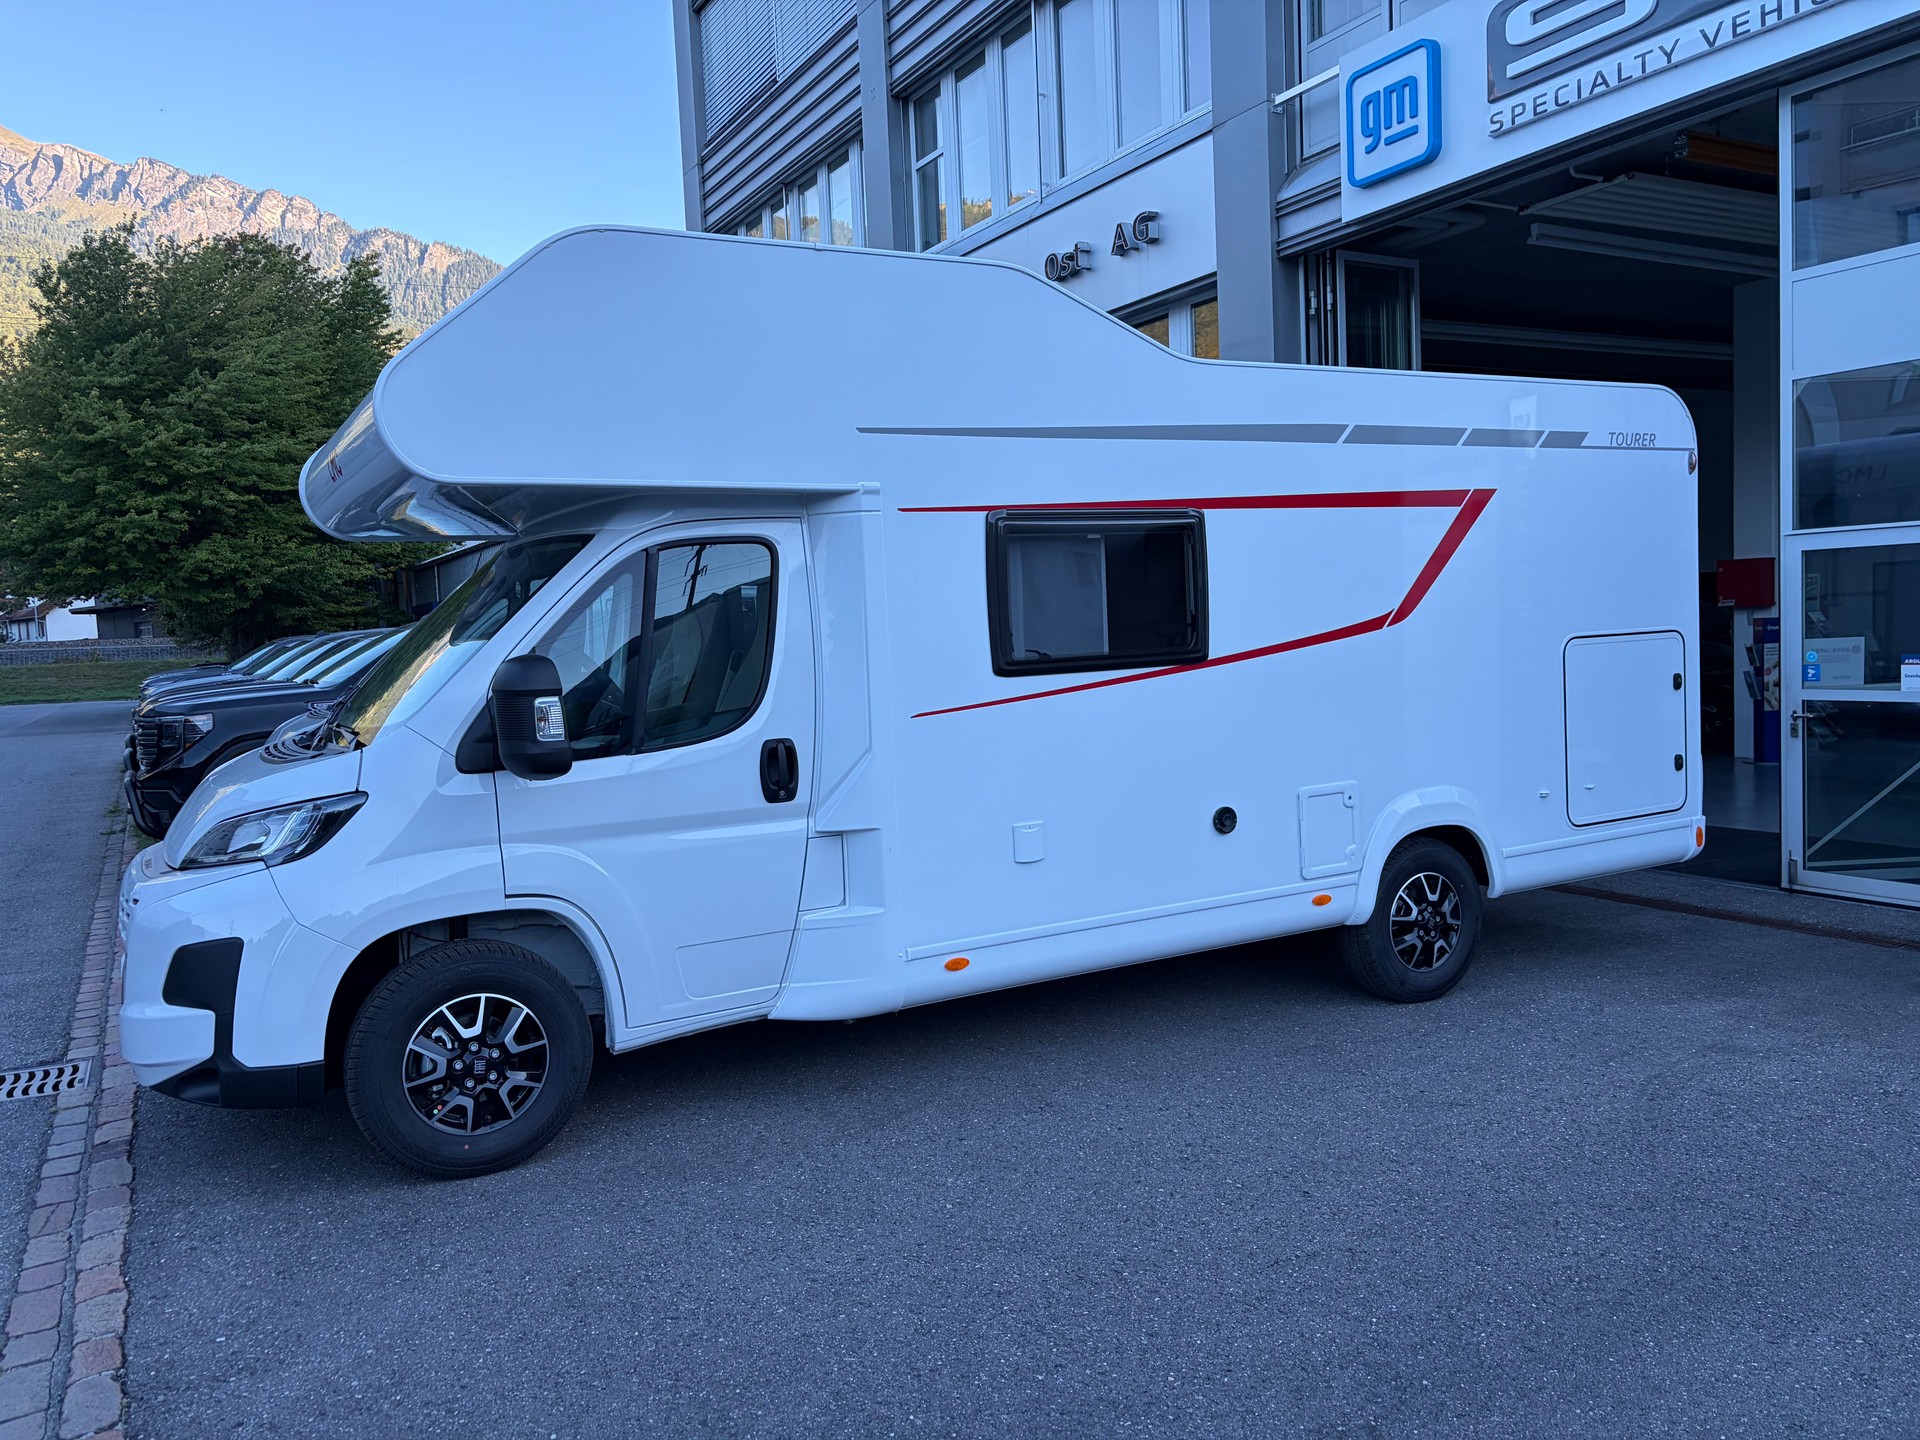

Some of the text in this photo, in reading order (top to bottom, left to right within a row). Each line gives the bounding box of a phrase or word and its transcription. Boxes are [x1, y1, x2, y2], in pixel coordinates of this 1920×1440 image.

[1489, 38, 1681, 134] SPECIALTY
[1699, 0, 1825, 48] VEHI
[1361, 75, 1419, 155] gm
[1045, 211, 1158, 281] Ost AG
[1608, 431, 1657, 447] TOURER
